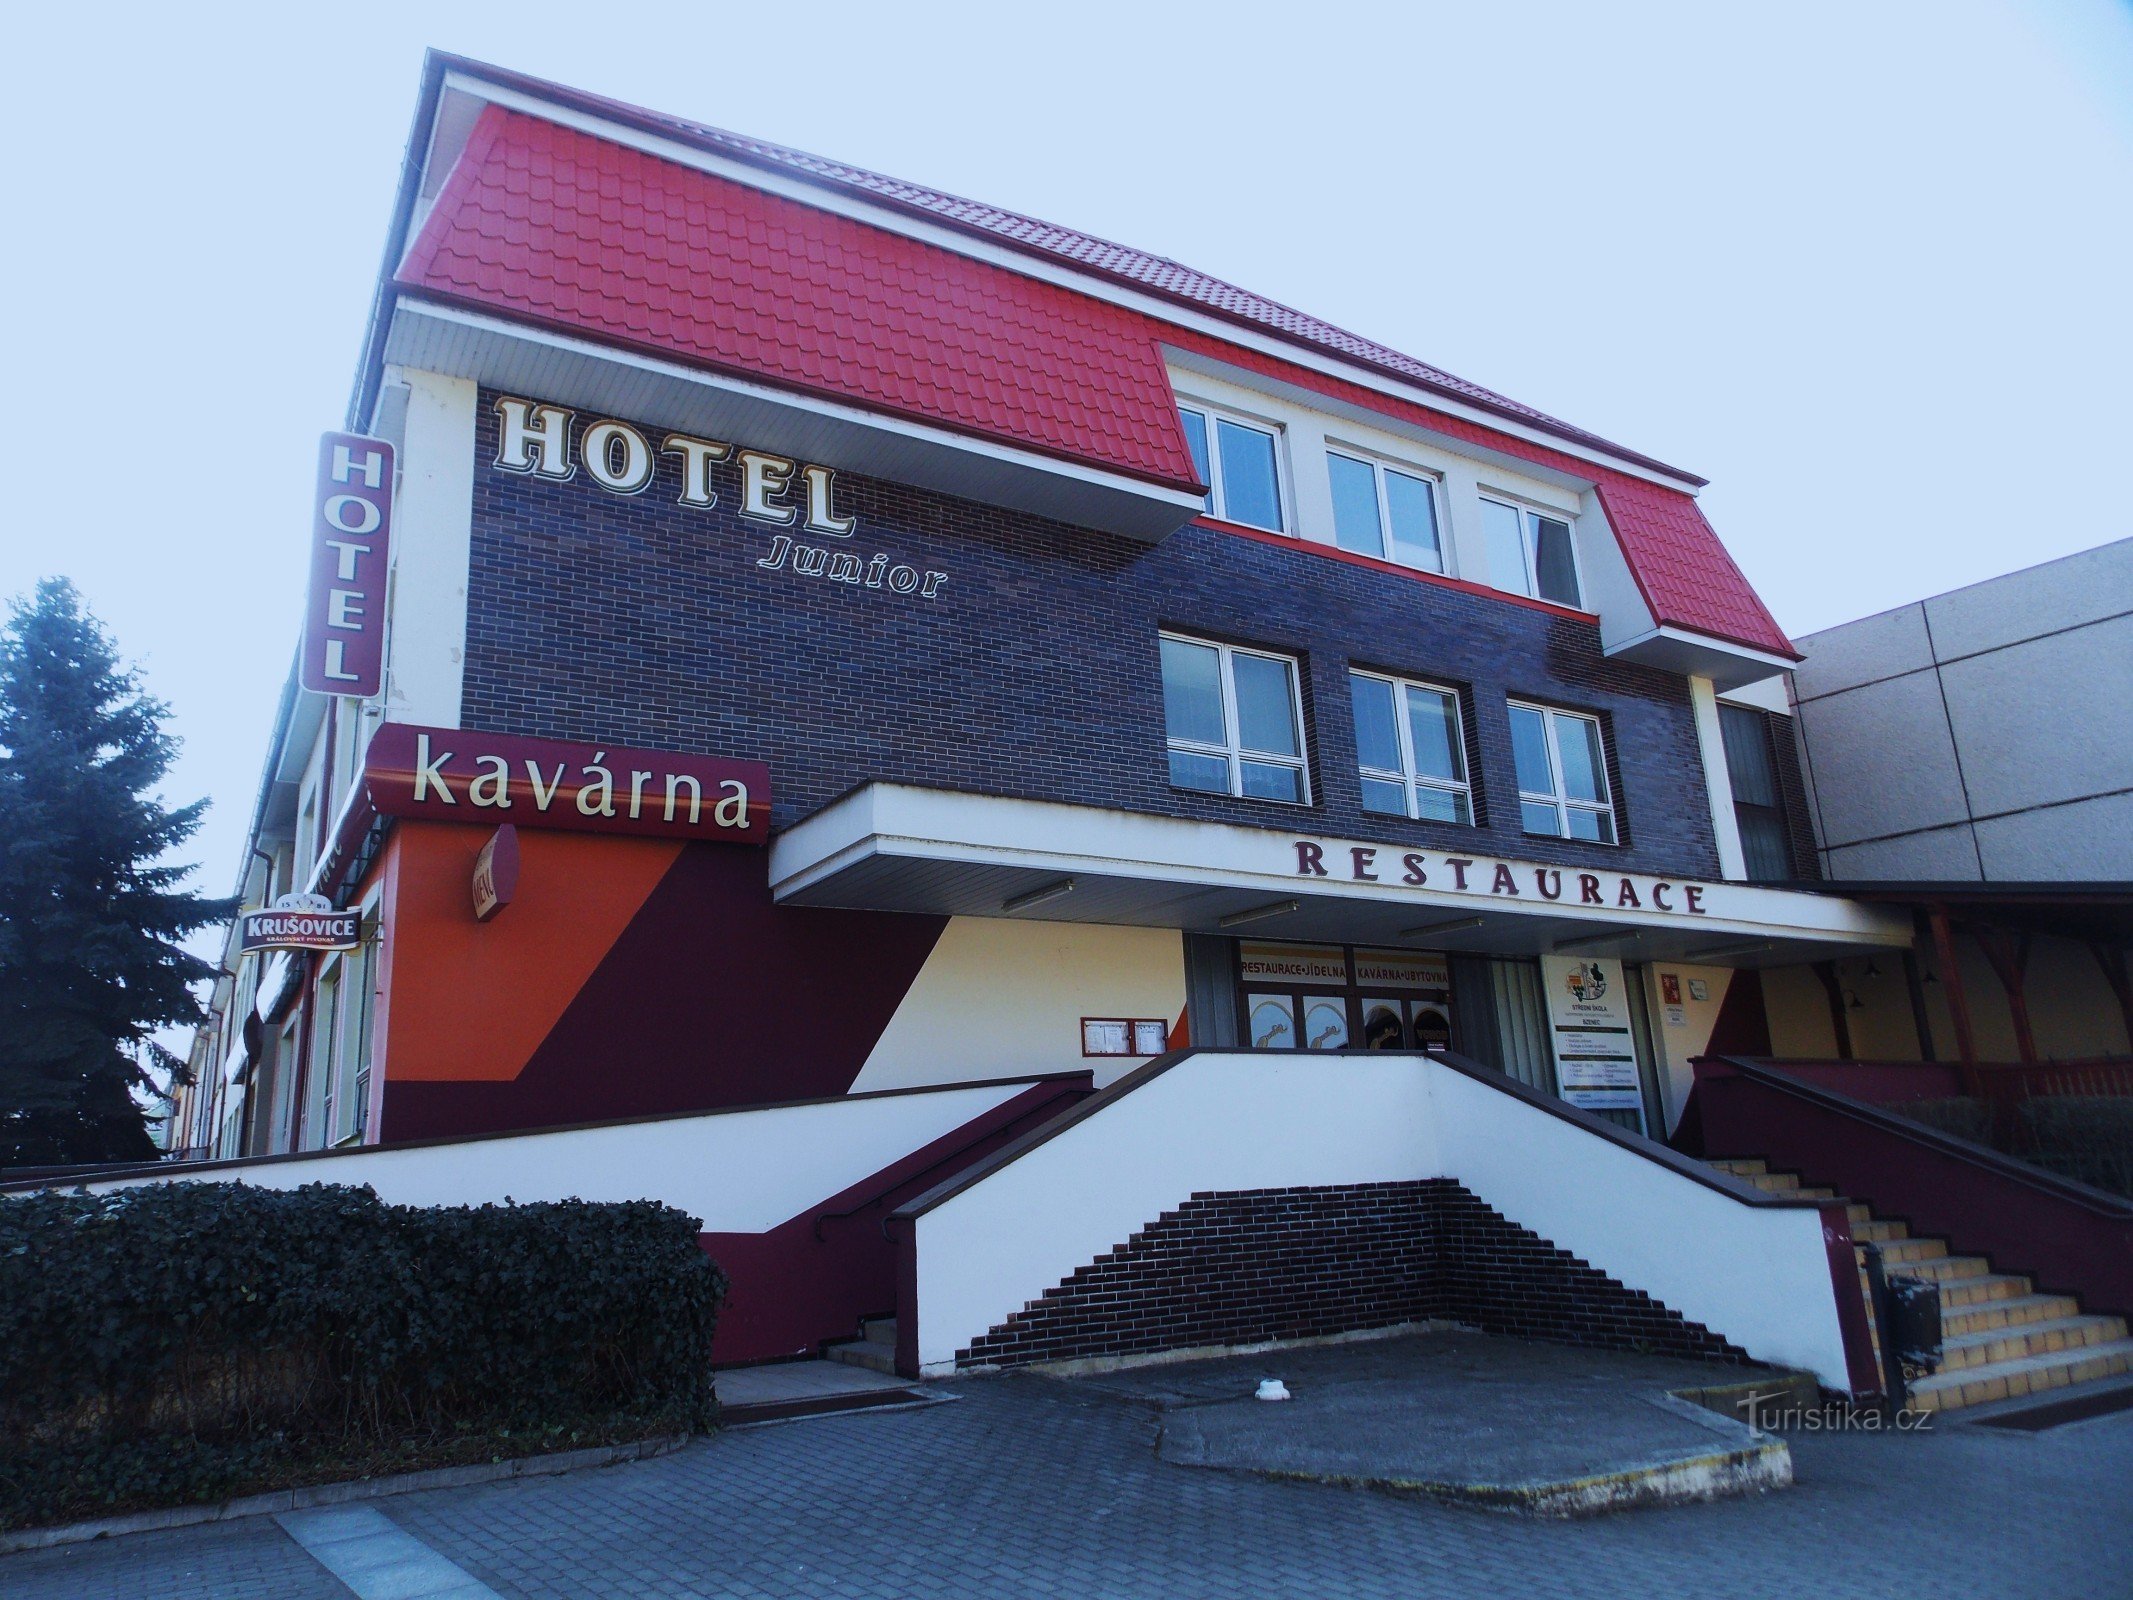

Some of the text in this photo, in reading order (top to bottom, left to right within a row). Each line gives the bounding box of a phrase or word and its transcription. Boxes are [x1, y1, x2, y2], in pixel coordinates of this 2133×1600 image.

[492, 396, 858, 538] HOTEL
[325, 446, 383, 681] HOTEL
[756, 534, 948, 598] Junior
[413, 733, 751, 830] kavárna
[1294, 840, 1707, 914] RESTAURACE
[248, 915, 355, 937] KRUŠOVICE
